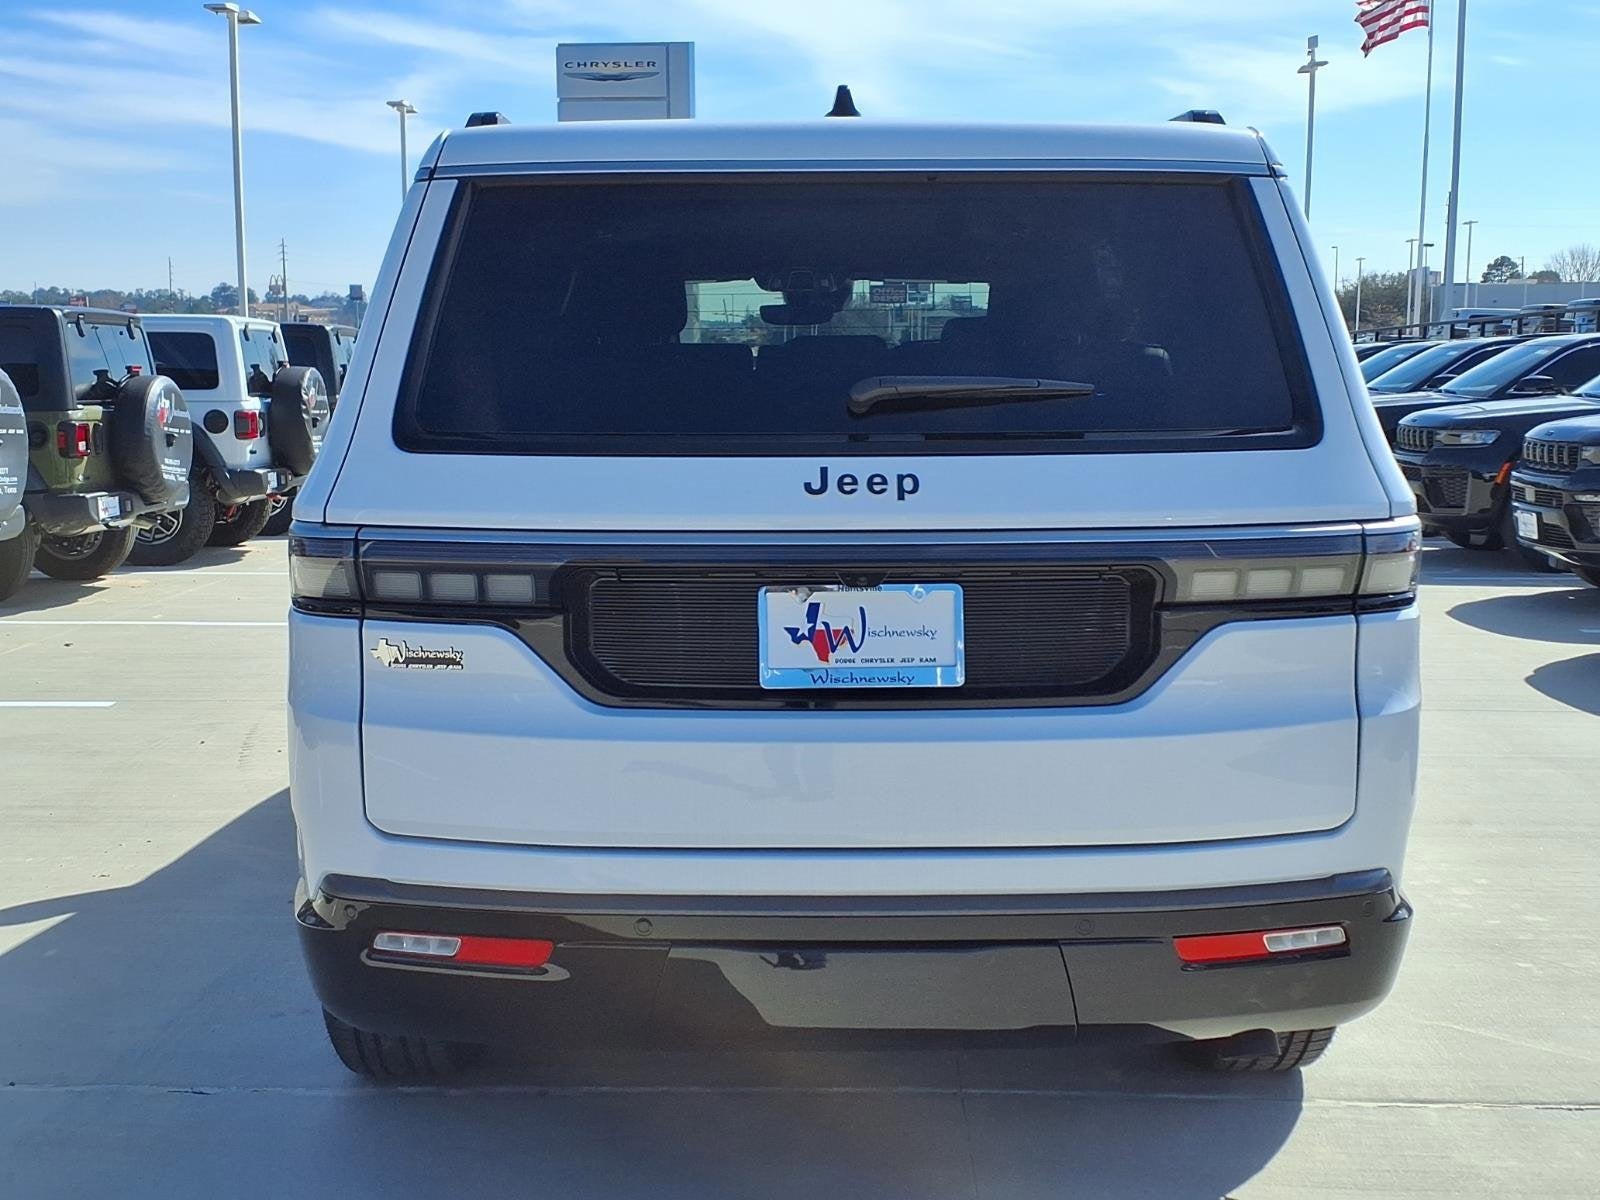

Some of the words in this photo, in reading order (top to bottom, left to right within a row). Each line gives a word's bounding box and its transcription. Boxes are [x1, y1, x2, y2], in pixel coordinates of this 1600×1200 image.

[564, 61, 657, 69] CHRYSLER
[803, 466, 920, 501] Jeep
[821, 606, 938, 654] Wischnewsky
[387, 640, 465, 663] Wischnewsky
[809, 668, 916, 686] Wischnewsky
